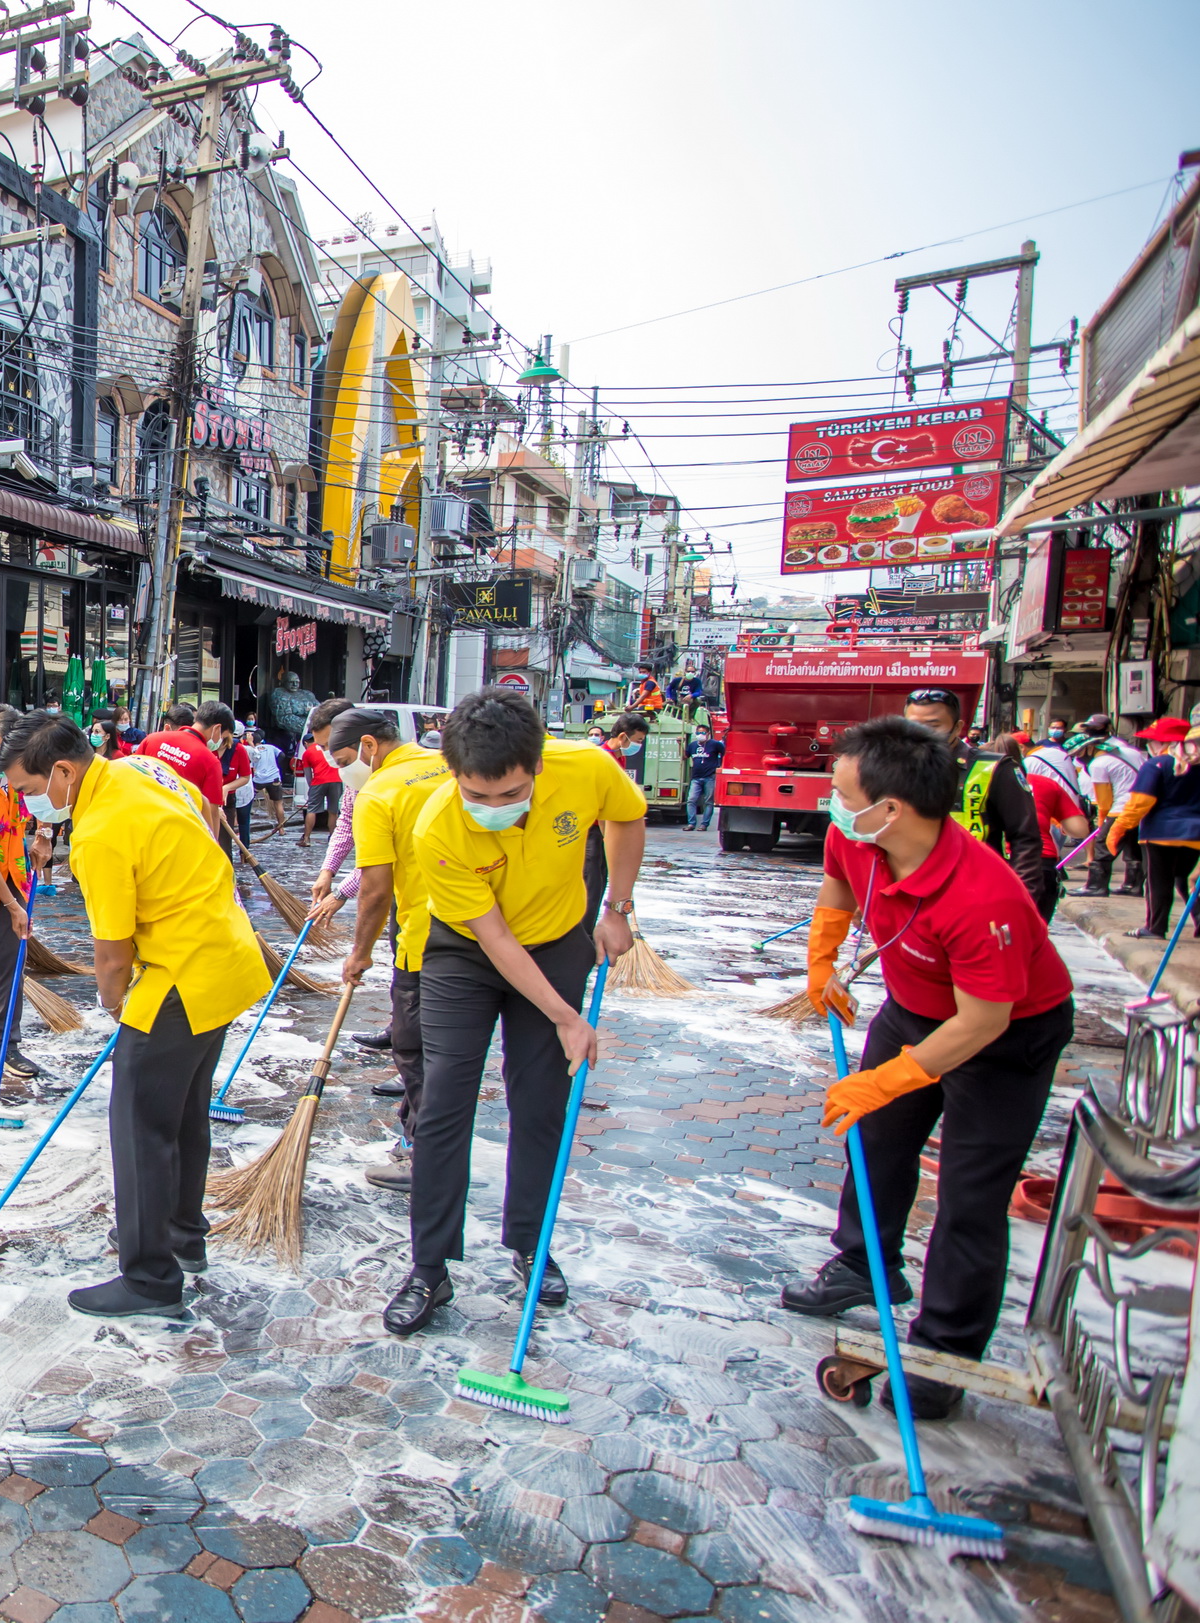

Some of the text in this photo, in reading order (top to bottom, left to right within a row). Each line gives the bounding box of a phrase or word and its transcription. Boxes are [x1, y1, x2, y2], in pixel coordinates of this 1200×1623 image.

[815, 407, 984, 438] TÜRKİYEM KEBAB
[961, 444, 987, 453] HALAL
[800, 461, 825, 469] HALAL
[823, 479, 955, 503] SAM'S FAST FOOD
[454, 607, 518, 621] CAVALLI
[875, 616, 937, 626] RESTAURANT
[886, 661, 957, 677] เมืองพัทยา
[160, 742, 191, 760] makro
[968, 784, 983, 838] AFFA
